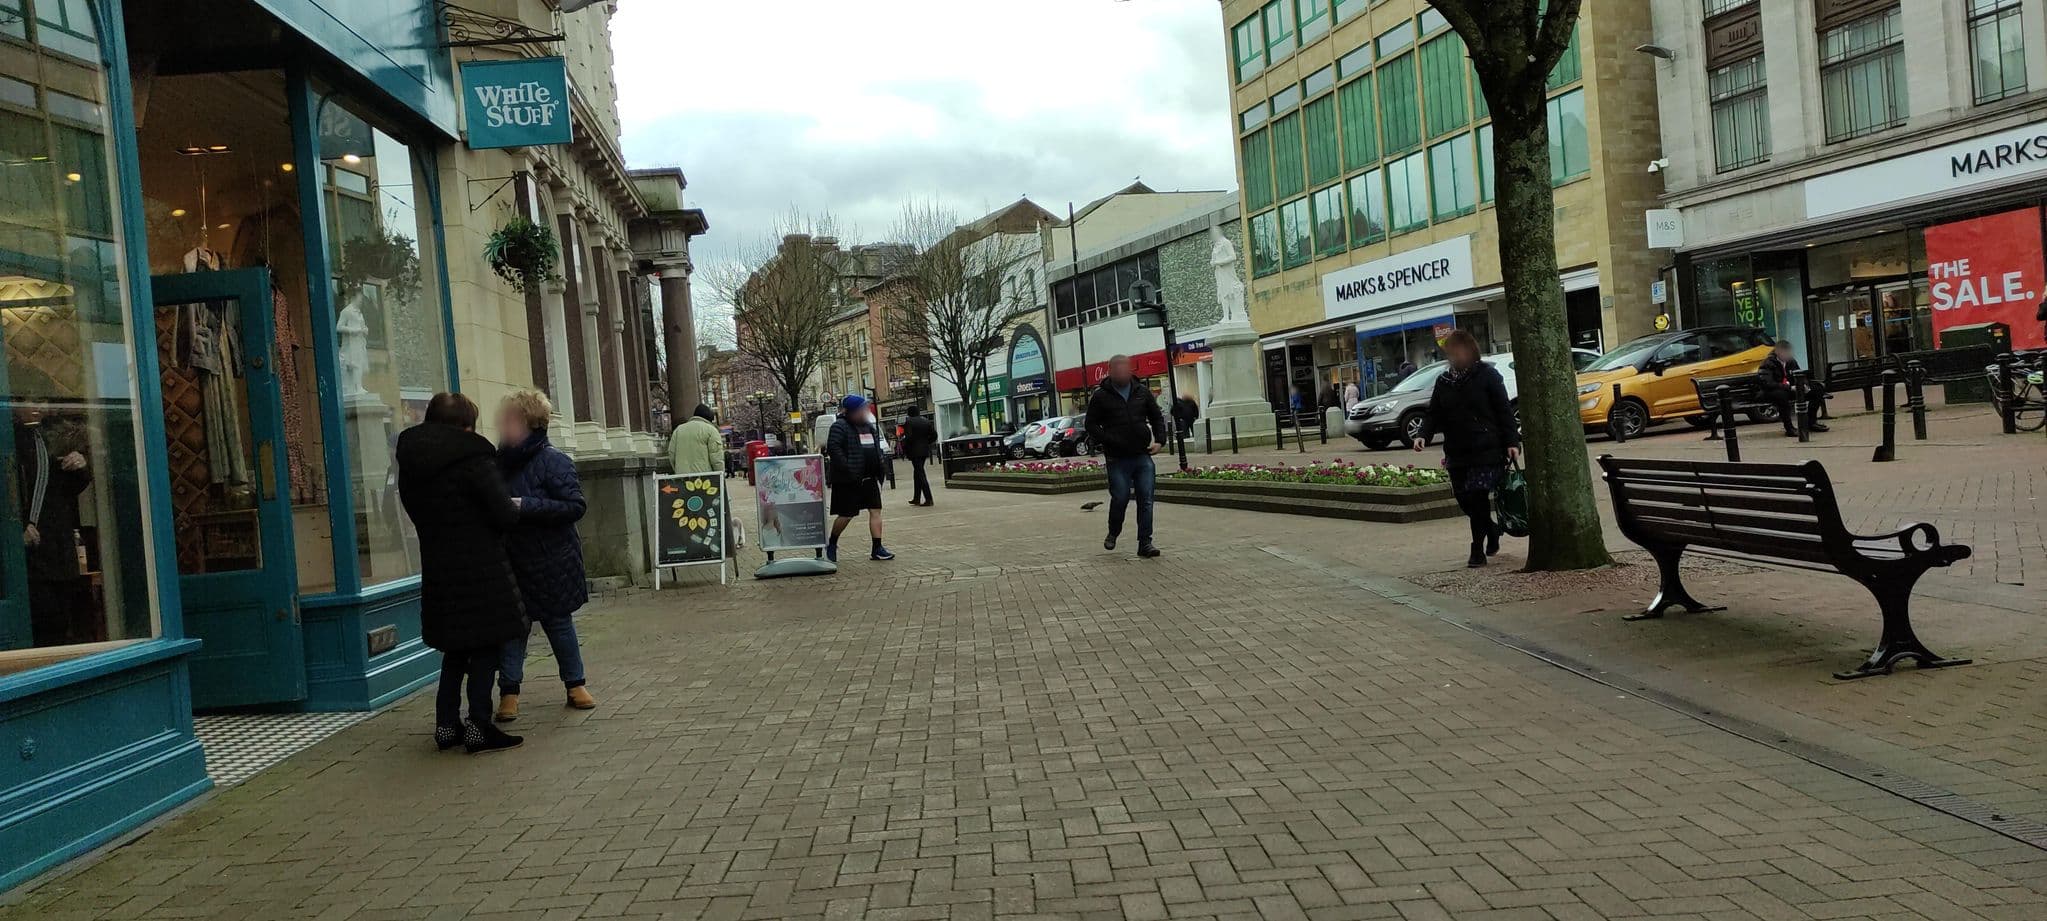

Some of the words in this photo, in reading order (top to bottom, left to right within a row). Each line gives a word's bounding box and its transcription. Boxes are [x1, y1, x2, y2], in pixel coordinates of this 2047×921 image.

[1951, 135, 2047, 178] MARKS
[1656, 221, 1676, 231] M&S
[1336, 277, 1376, 302] MARKS
[1377, 275, 1387, 292] &
[1387, 258, 1450, 290] SPENCER
[1931, 259, 1971, 280] THE
[1932, 270, 2035, 311] SALE.
